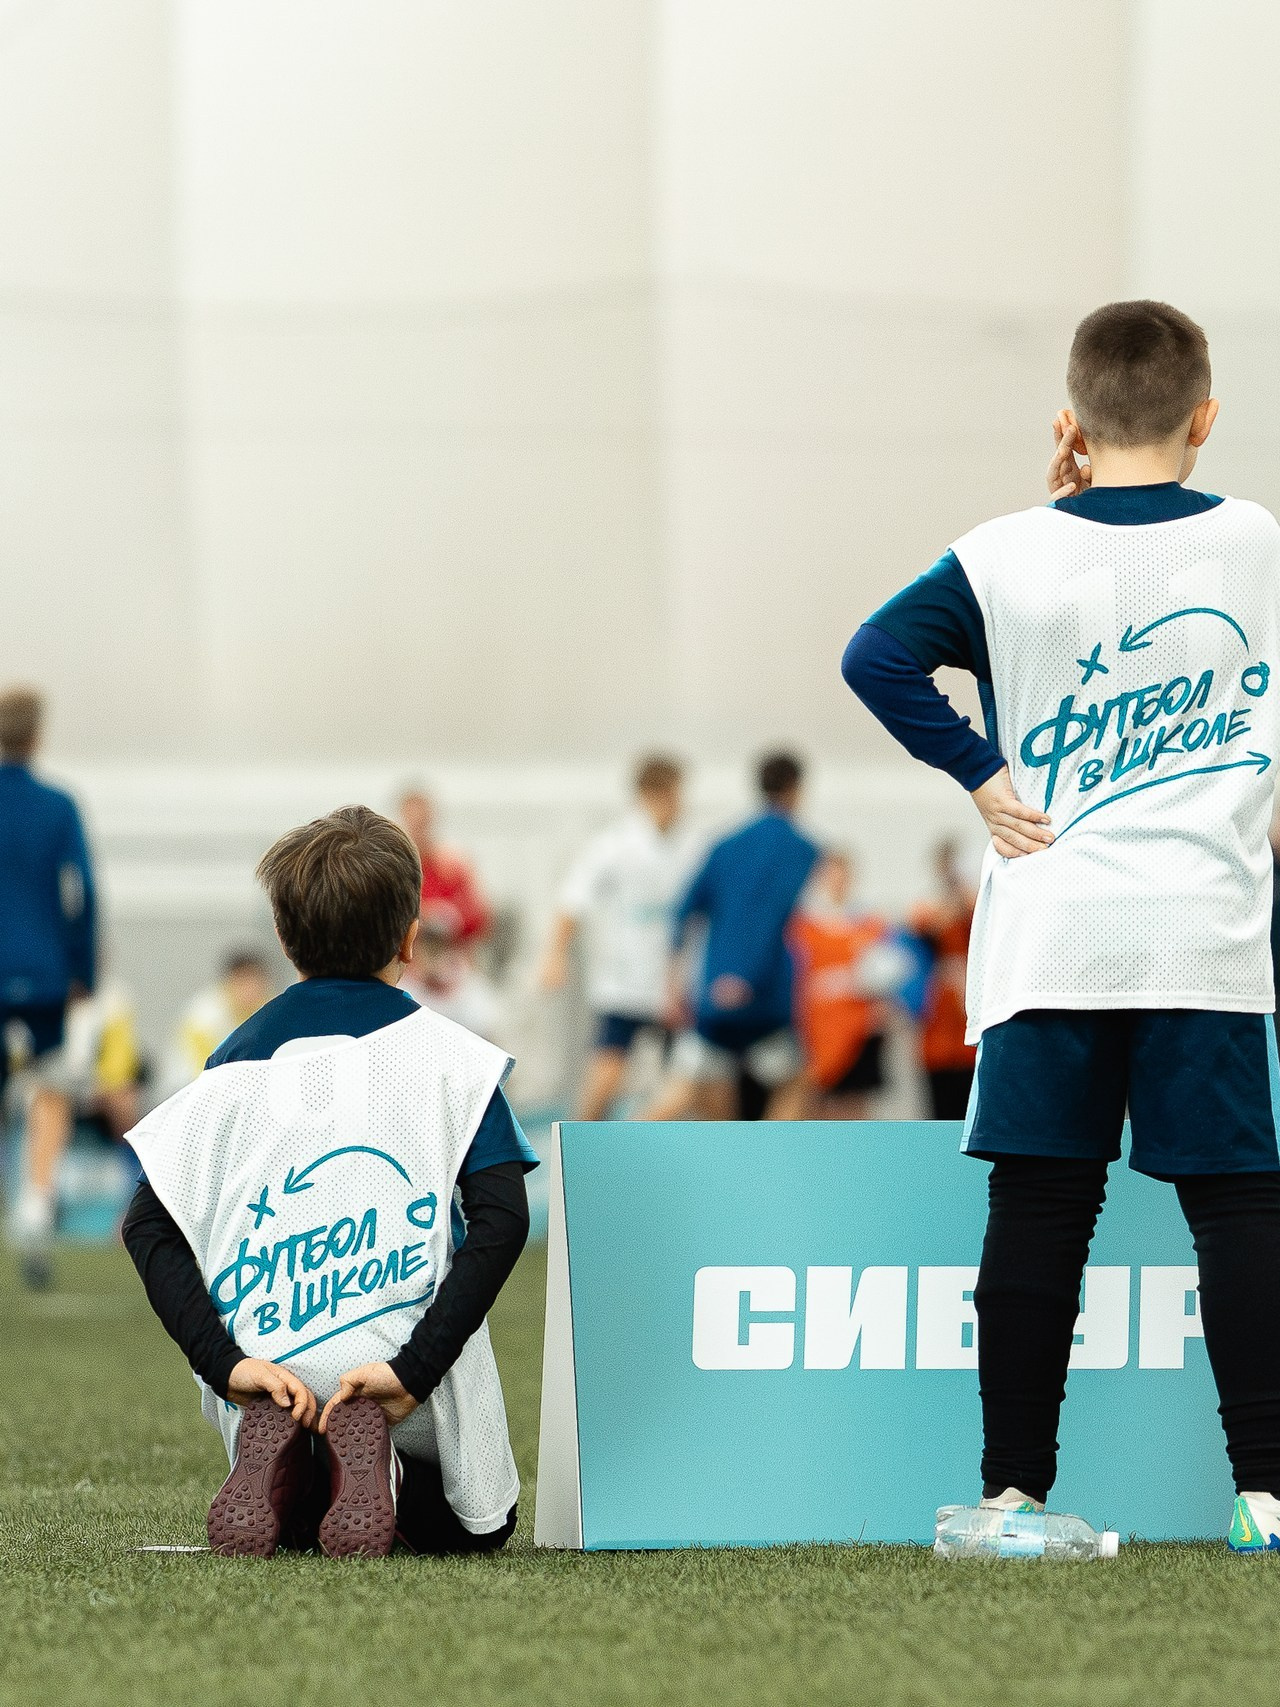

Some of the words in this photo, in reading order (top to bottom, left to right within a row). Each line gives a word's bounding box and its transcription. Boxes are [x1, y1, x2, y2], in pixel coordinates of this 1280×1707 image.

[1020, 669, 1214, 813] ФУТБОЛ
[1078, 759, 1104, 793] В
[1110, 708, 1252, 783] ШКОЛЕ
[209, 1207, 378, 1345] ФУТБОЛ
[252, 1301, 282, 1336] В
[288, 1241, 429, 1332] ШКОЛЕ
